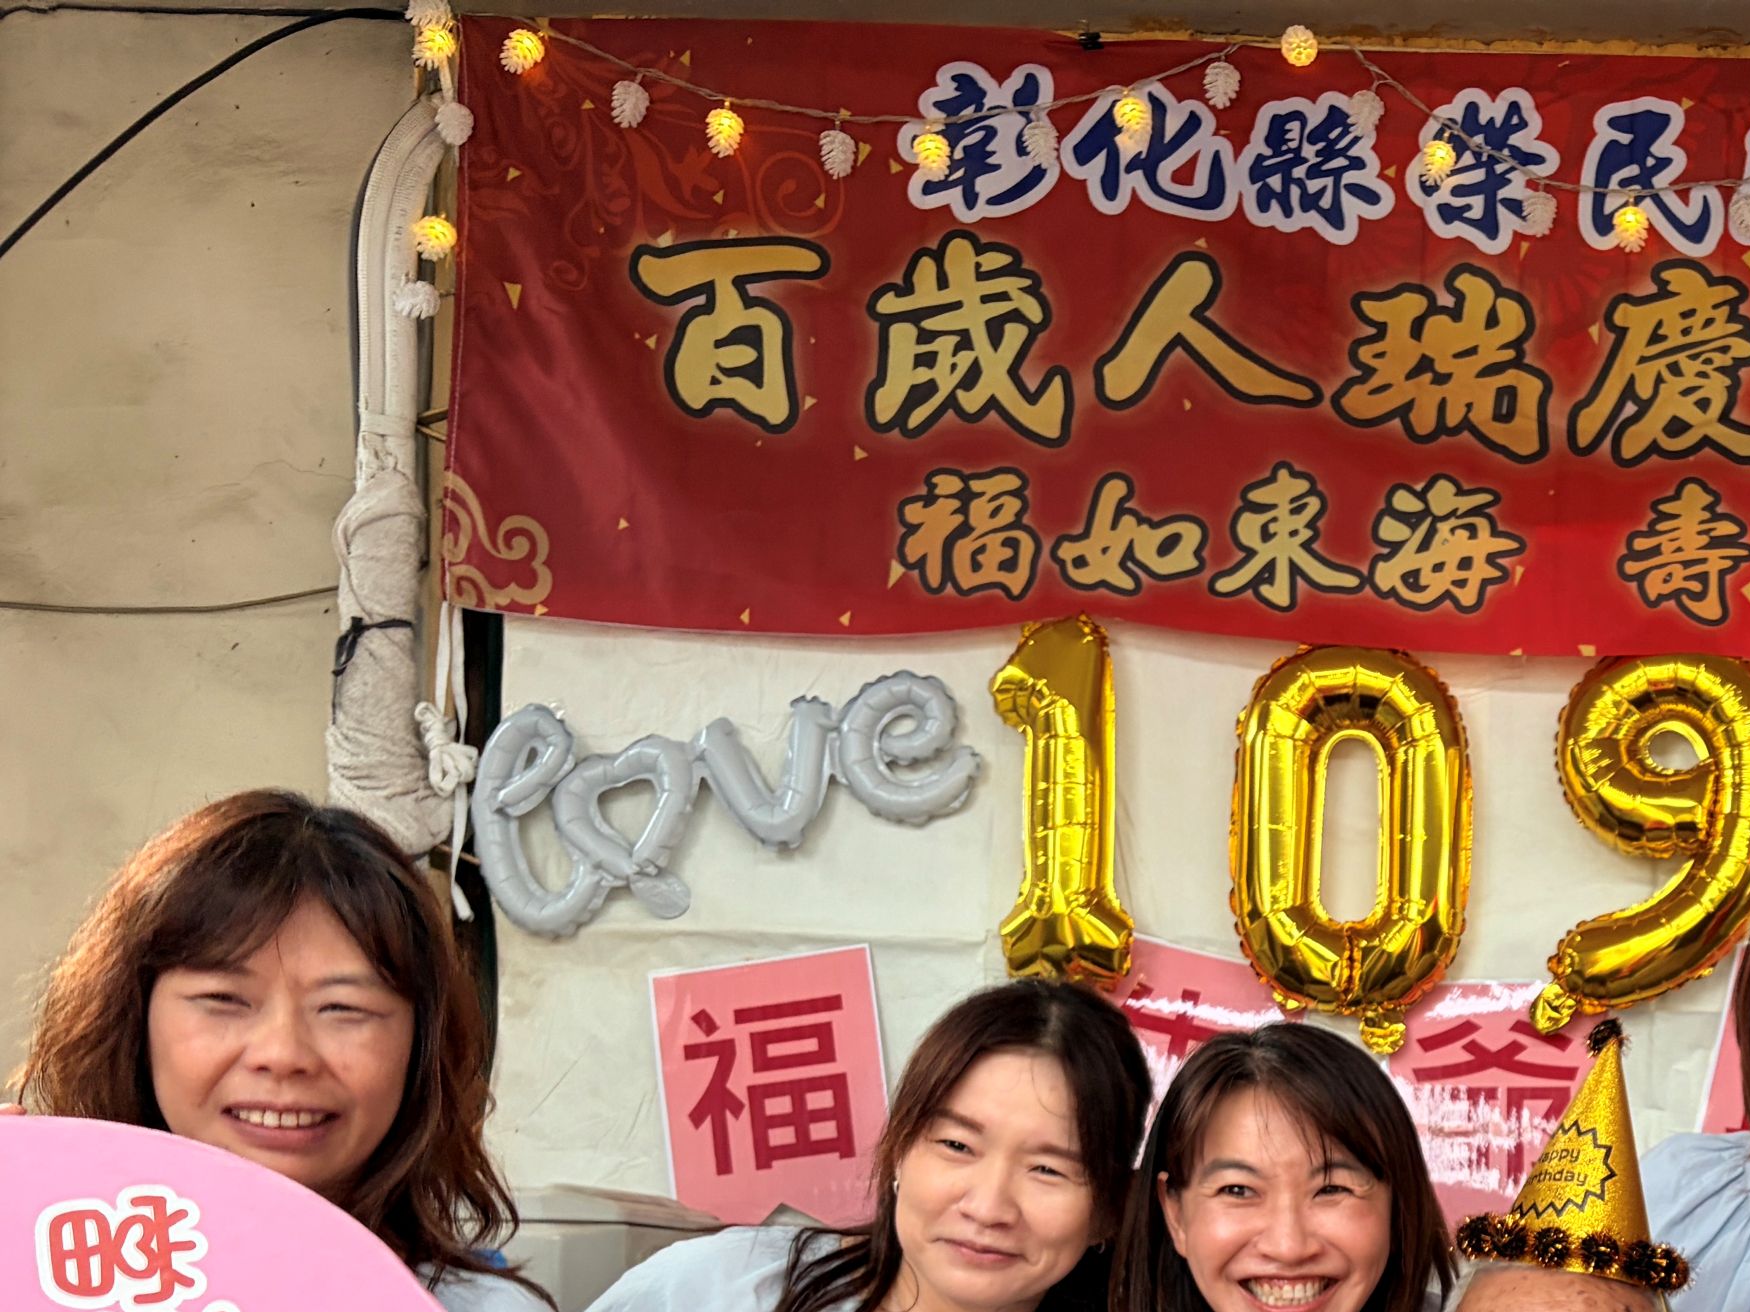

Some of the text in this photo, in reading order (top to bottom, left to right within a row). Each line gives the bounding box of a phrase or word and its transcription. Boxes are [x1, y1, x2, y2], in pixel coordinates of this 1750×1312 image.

[898, 463, 1526, 611] 福如東海
[683, 994, 856, 1176] 福
[1526, 1168, 1588, 1187] rthday
[1538, 1148, 1581, 1164] appy
